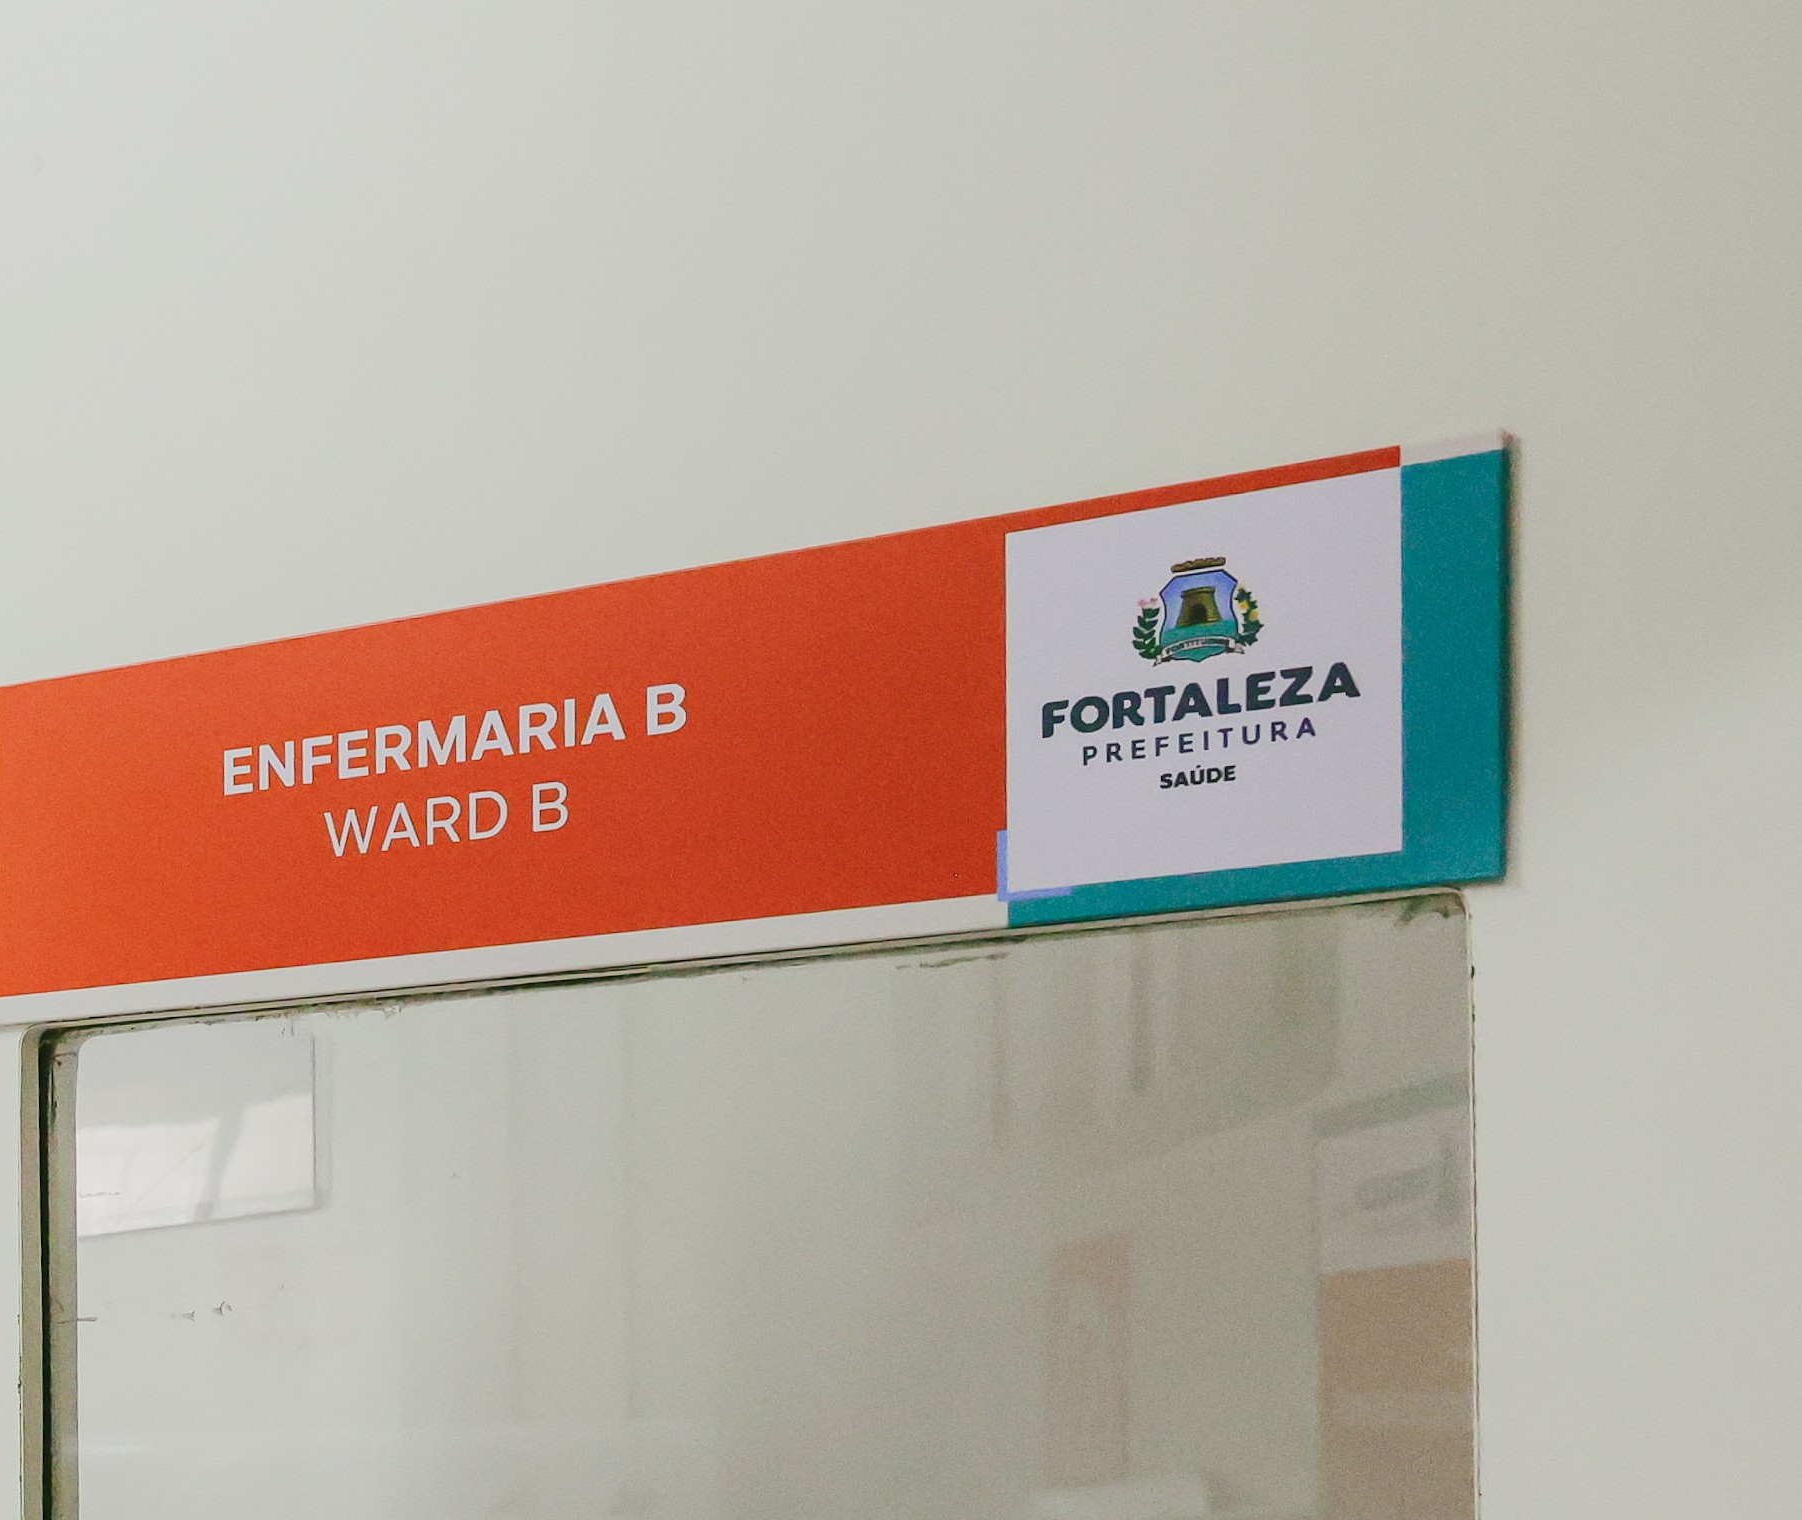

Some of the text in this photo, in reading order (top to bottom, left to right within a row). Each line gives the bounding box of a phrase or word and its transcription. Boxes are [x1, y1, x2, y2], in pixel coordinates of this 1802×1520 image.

[1042, 662, 1361, 739] FORTALEZA
[223, 683, 688, 796] ENFERMARIA B
[1083, 717, 1316, 766] PREFEITURA
[1160, 765, 1236, 789] SAÚDE
[324, 781, 569, 857] WARD B
